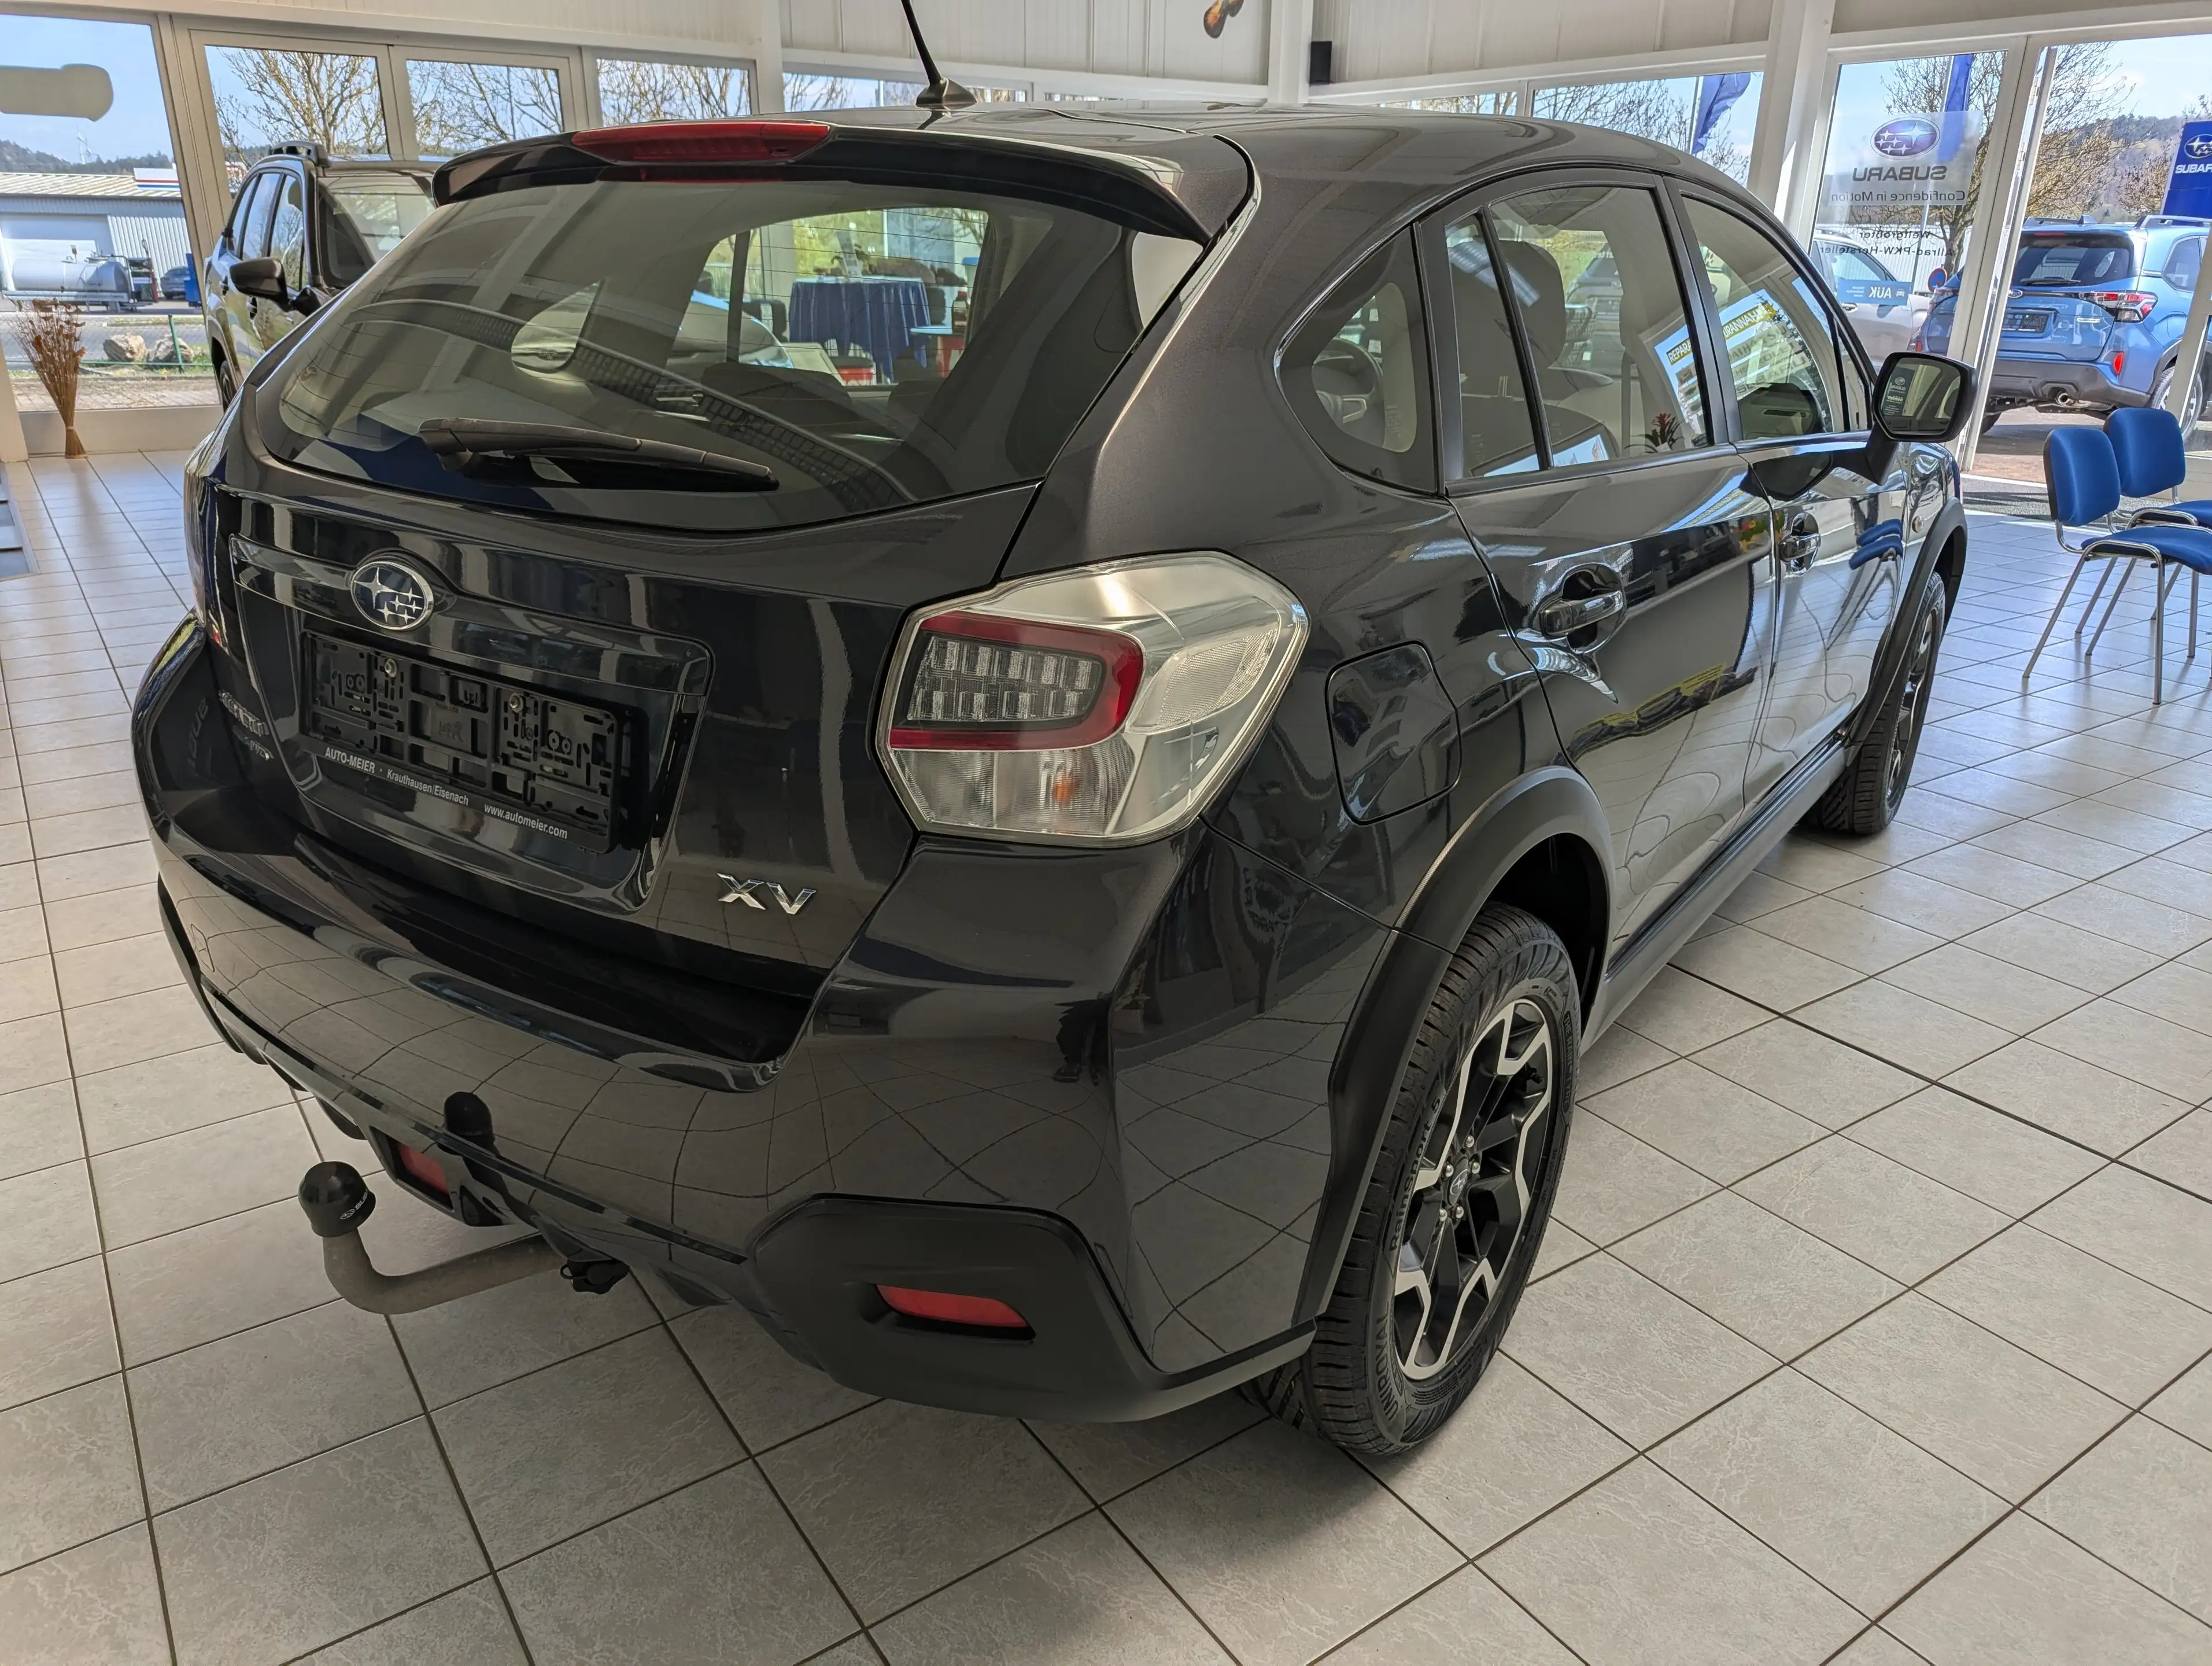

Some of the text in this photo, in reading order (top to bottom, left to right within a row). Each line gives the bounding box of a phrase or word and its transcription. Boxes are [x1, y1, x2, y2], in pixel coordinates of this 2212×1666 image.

[1723, 303, 1775, 338] URANNAH
[325, 747, 375, 774] AUTO-MEIER
[386, 768, 469, 806] Krauthausen/Eisenach
[483, 802, 568, 839] www.automeier.com
[717, 872, 817, 915] XV
[1375, 1301, 1399, 1421] UNIROYAL
